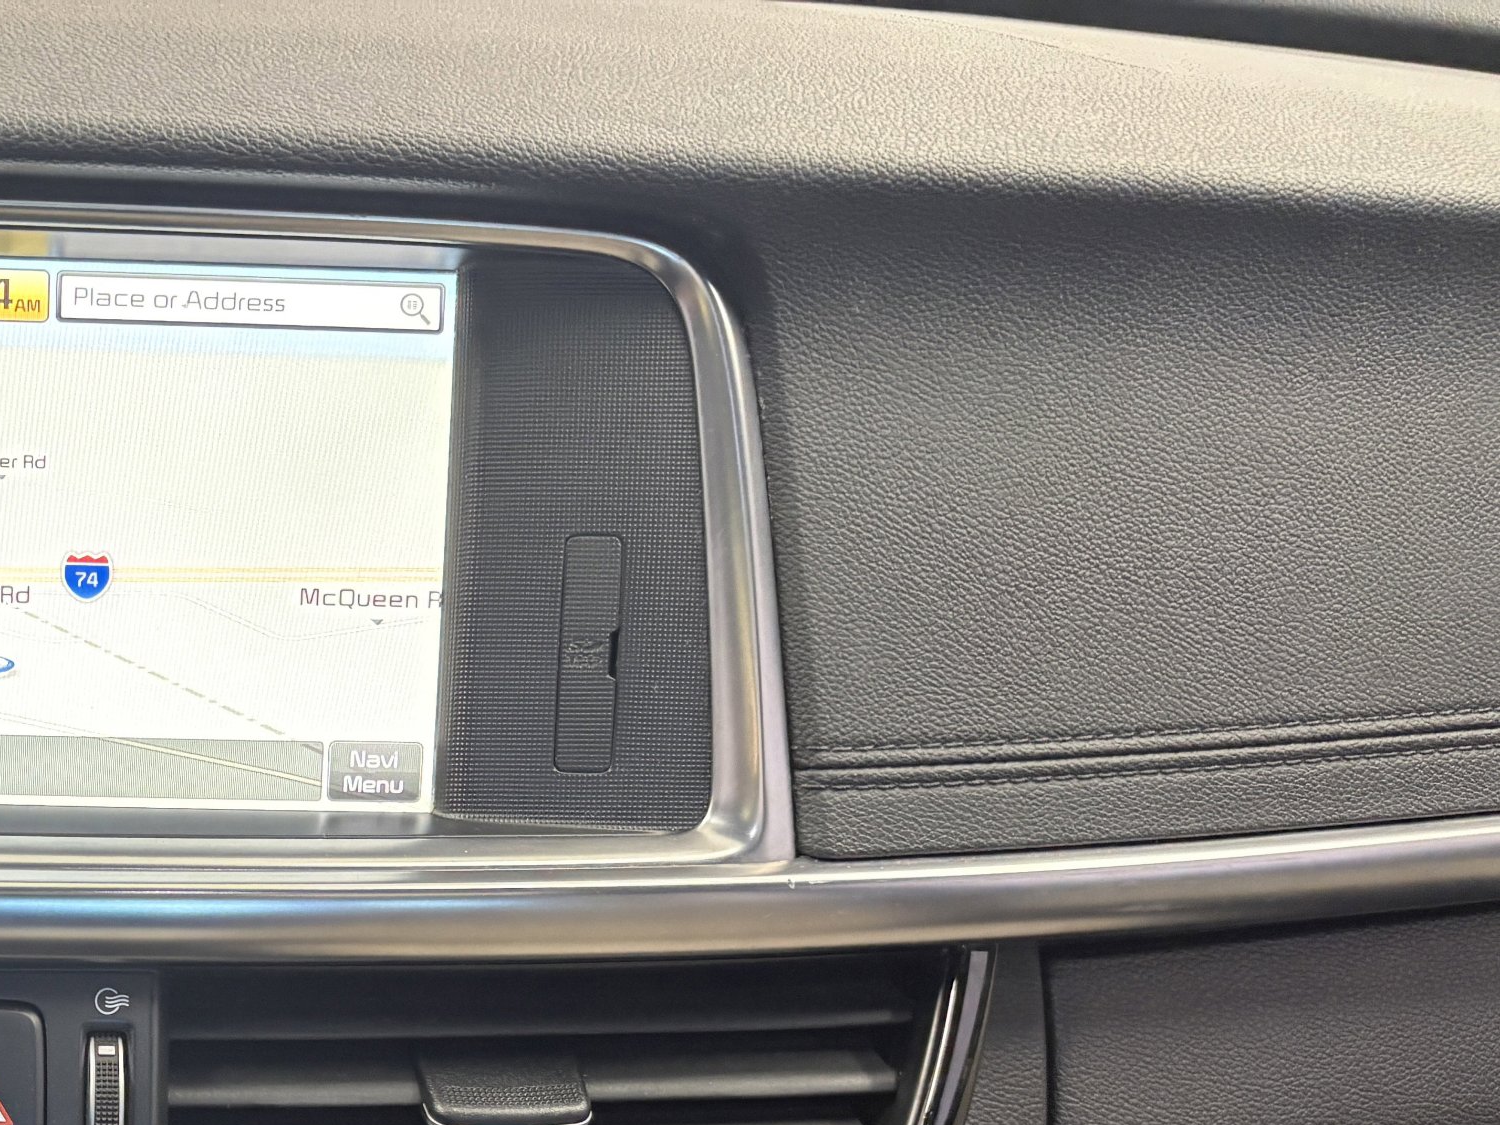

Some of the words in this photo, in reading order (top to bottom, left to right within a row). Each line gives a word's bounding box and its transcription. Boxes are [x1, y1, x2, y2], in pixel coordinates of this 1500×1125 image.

[14, 299, 41, 314] AM
[73, 287, 144, 308] Place
[153, 294, 177, 309] or
[185, 291, 286, 313] Address
[23, 454, 46, 470] Rd
[75, 571, 99, 587] 74
[1, 585, 30, 604] Rd
[300, 588, 418, 609] McQueen
[350, 750, 399, 769] Navi
[343, 776, 404, 795] Menu
